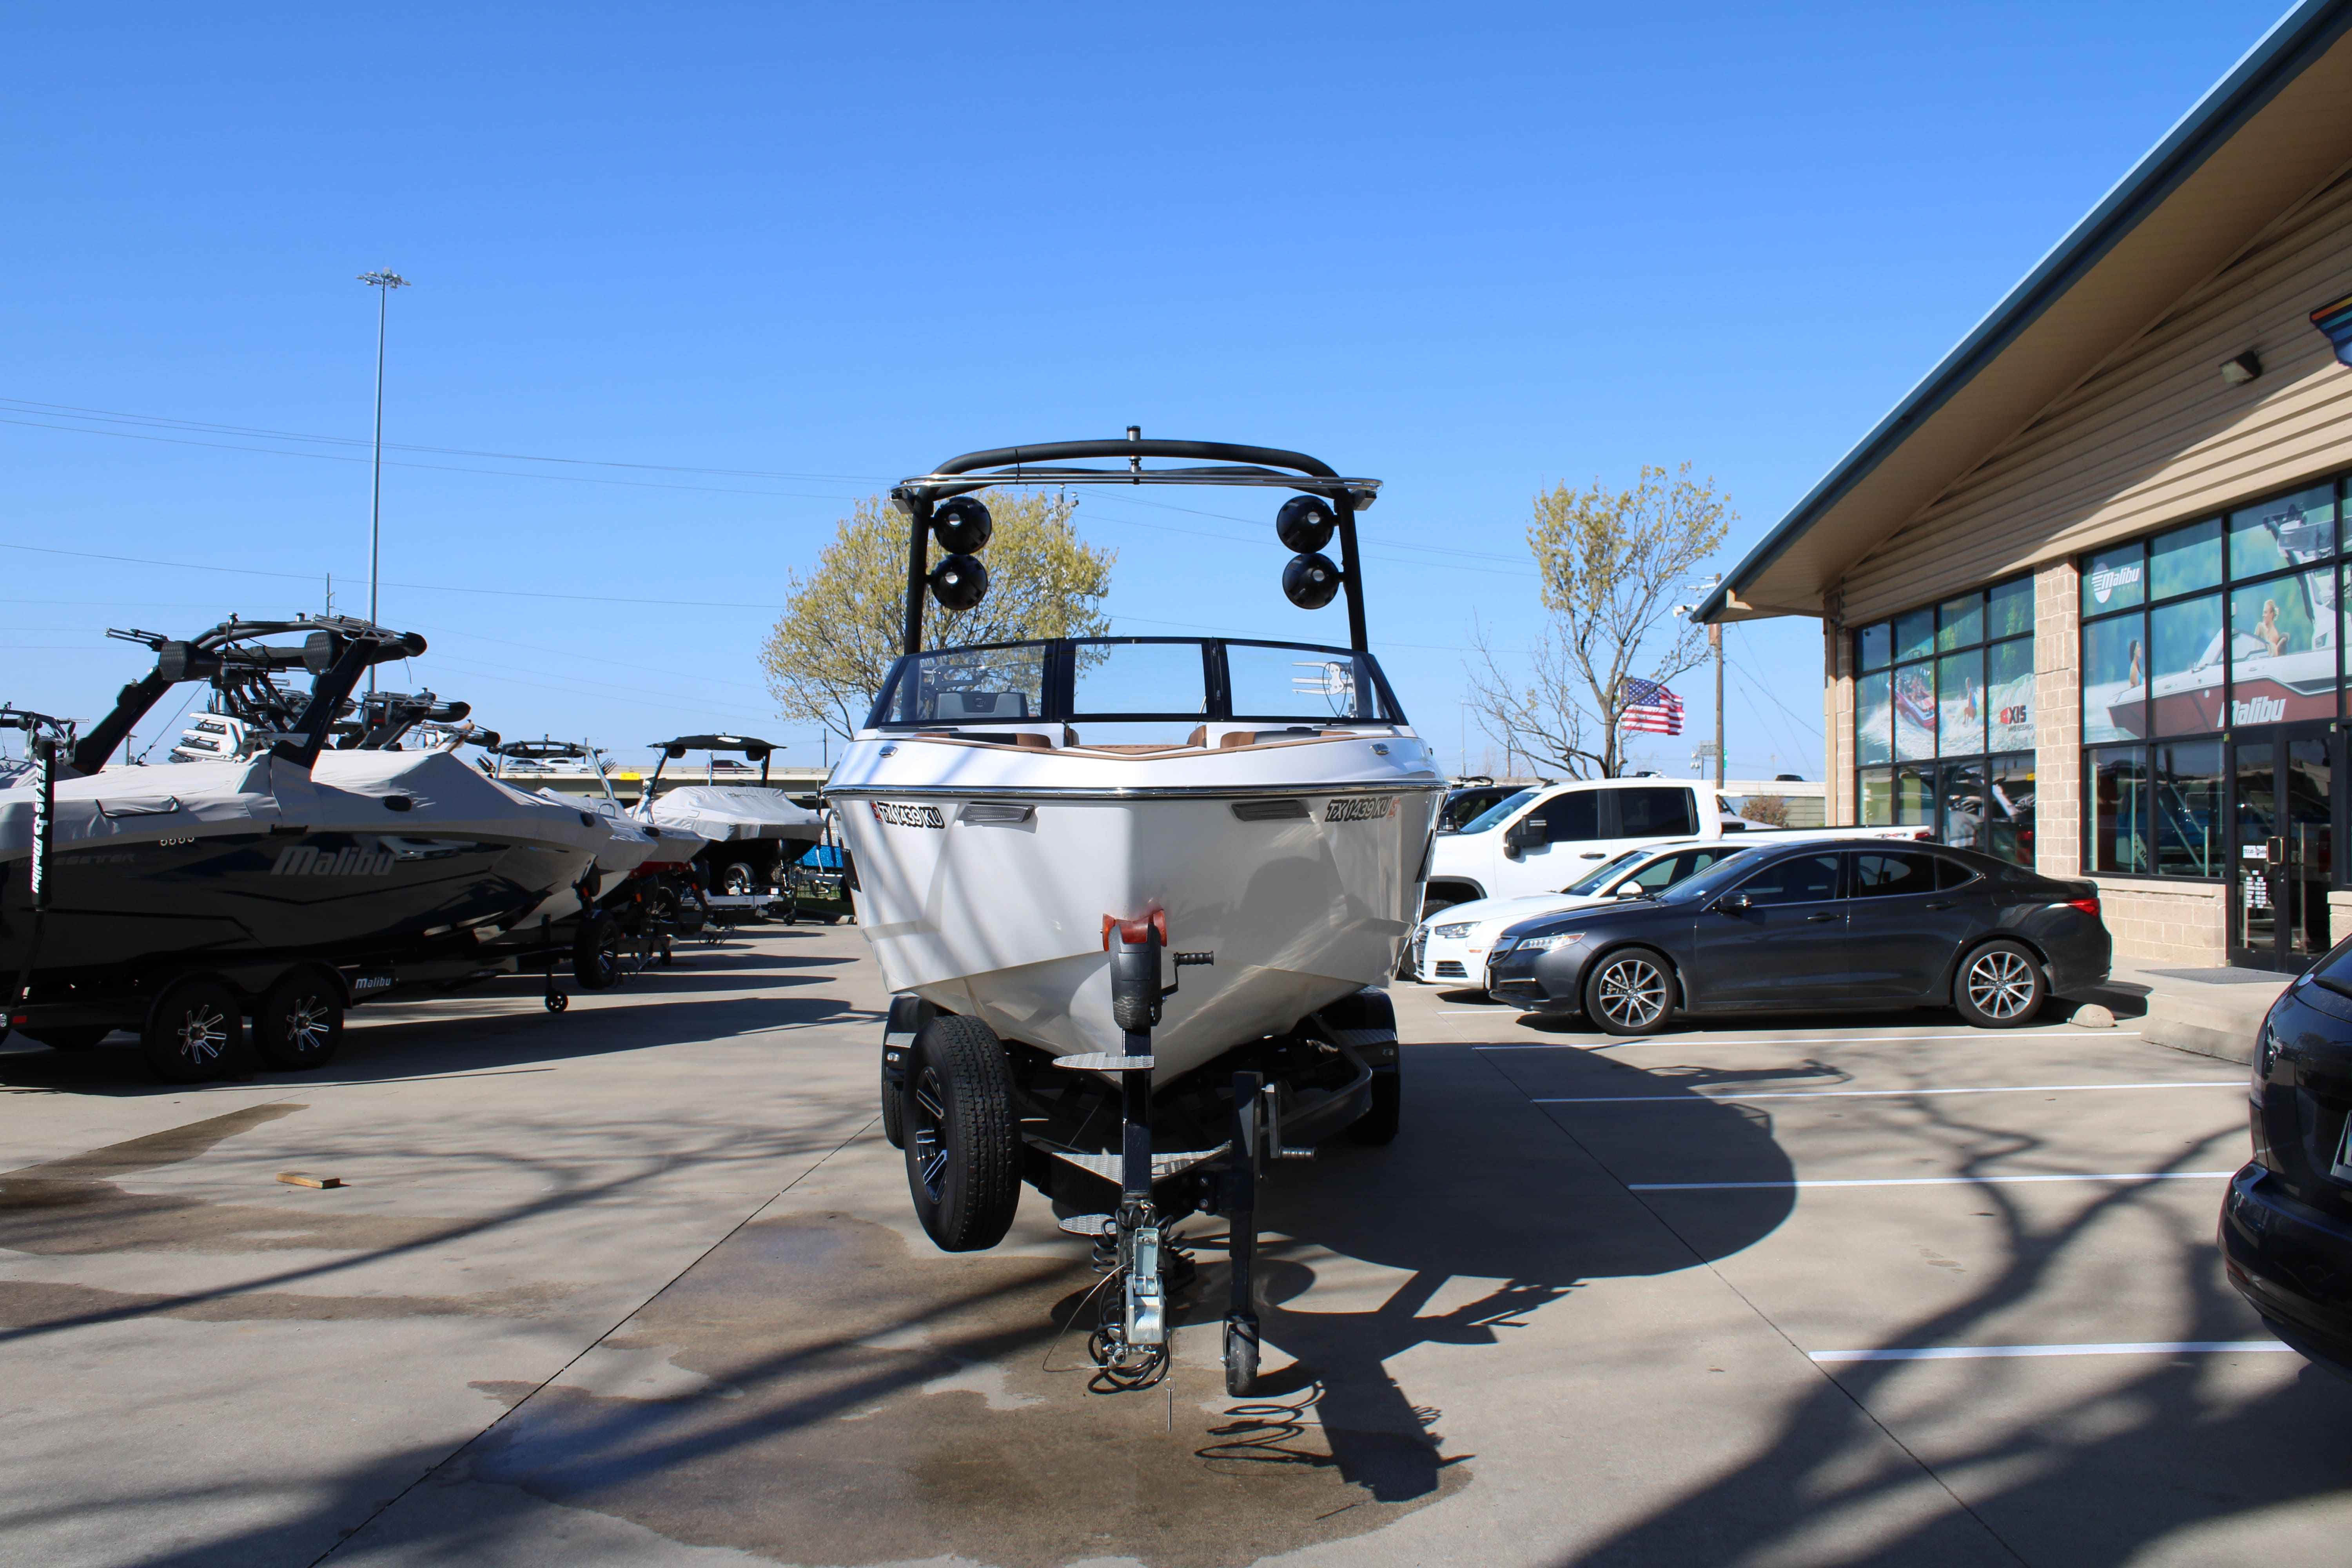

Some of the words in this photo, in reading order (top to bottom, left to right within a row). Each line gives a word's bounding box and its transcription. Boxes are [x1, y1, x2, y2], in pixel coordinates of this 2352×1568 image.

[2101, 567, 2140, 589] Malibu
[2217, 696, 2287, 728] Malibu
[35, 759, 47, 814] TEXAS
[878, 802, 897, 824] TX
[893, 805, 923, 827] 1439
[919, 808, 944, 828] KU
[1326, 800, 1348, 820] TX
[1345, 799, 1375, 820] 1439
[1372, 797, 1392, 817] KU
[32, 835, 43, 894] Malibu
[270, 846, 396, 876] Malibu
[355, 977, 391, 989] Malibu
